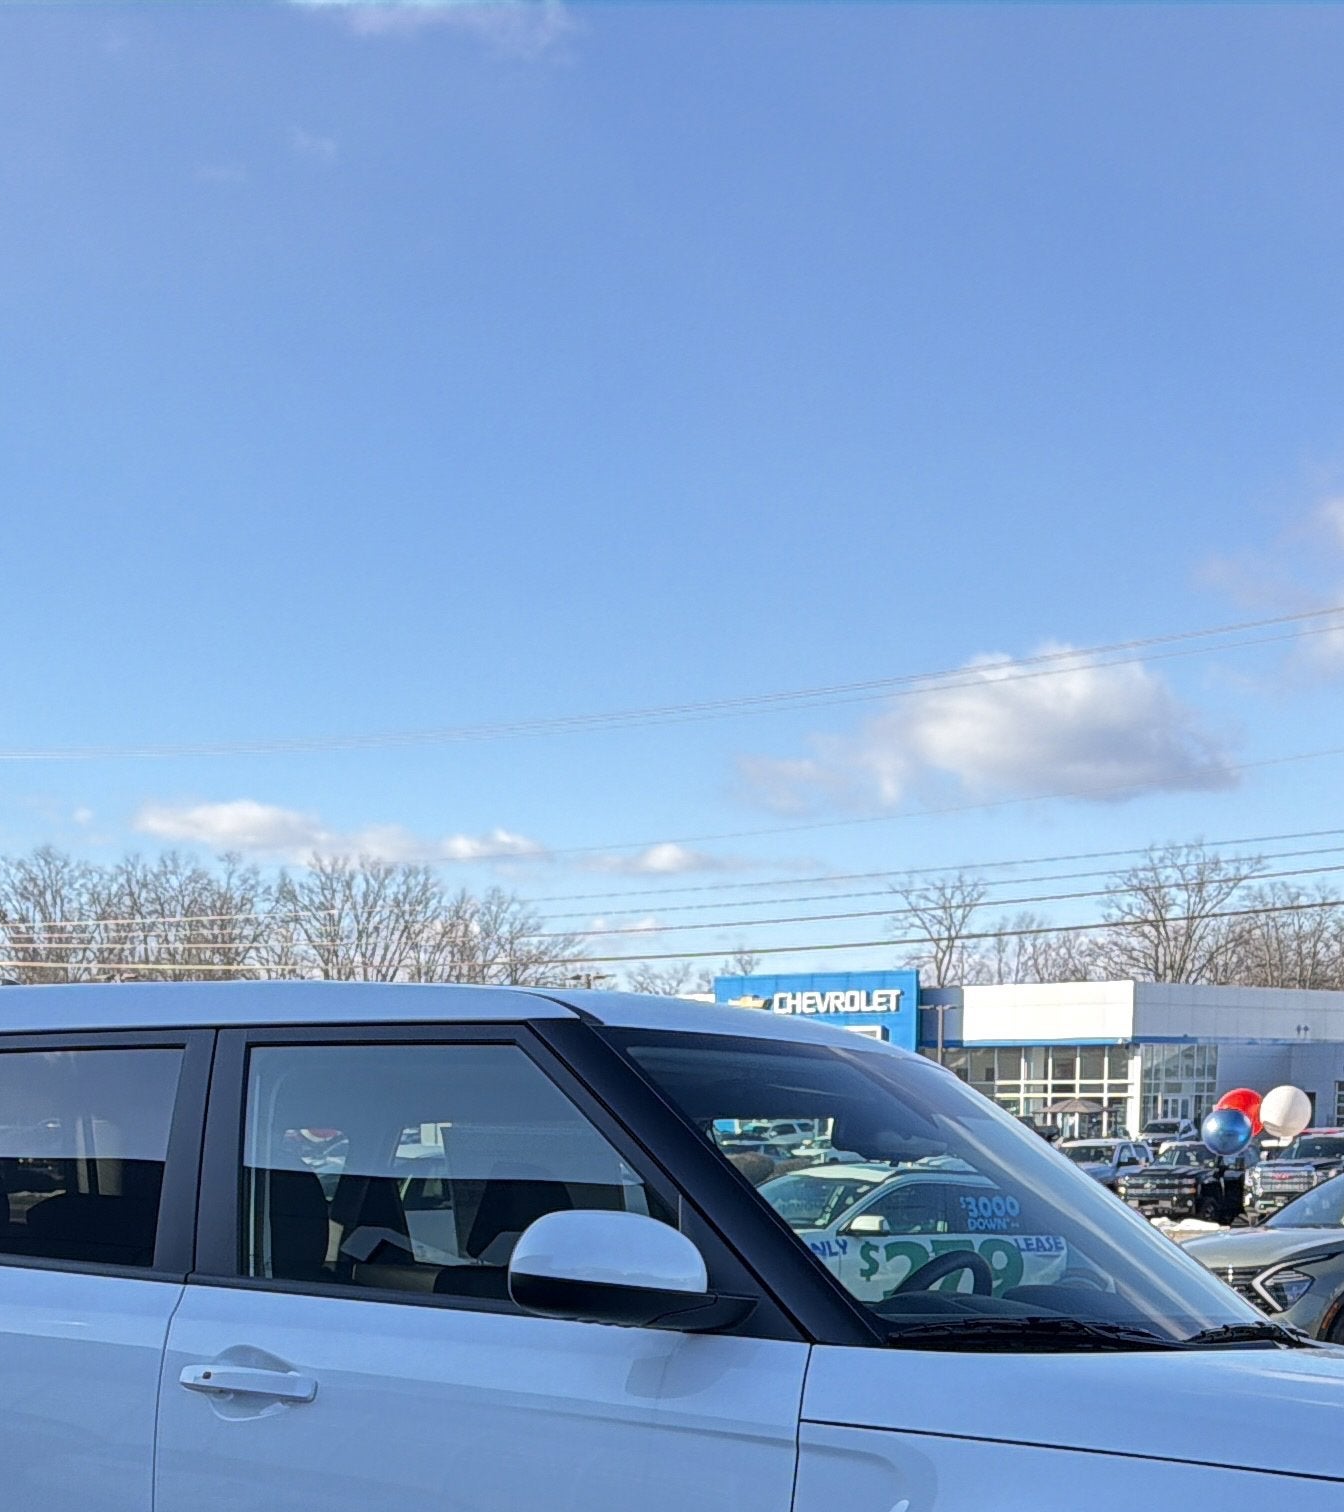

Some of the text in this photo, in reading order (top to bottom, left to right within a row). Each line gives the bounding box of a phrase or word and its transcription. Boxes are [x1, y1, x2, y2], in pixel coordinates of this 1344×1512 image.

[773, 989, 903, 1015] CHEVROLET
[810, 1238, 848, 1258] NLY
[1014, 1236, 1065, 1252] LEASE
